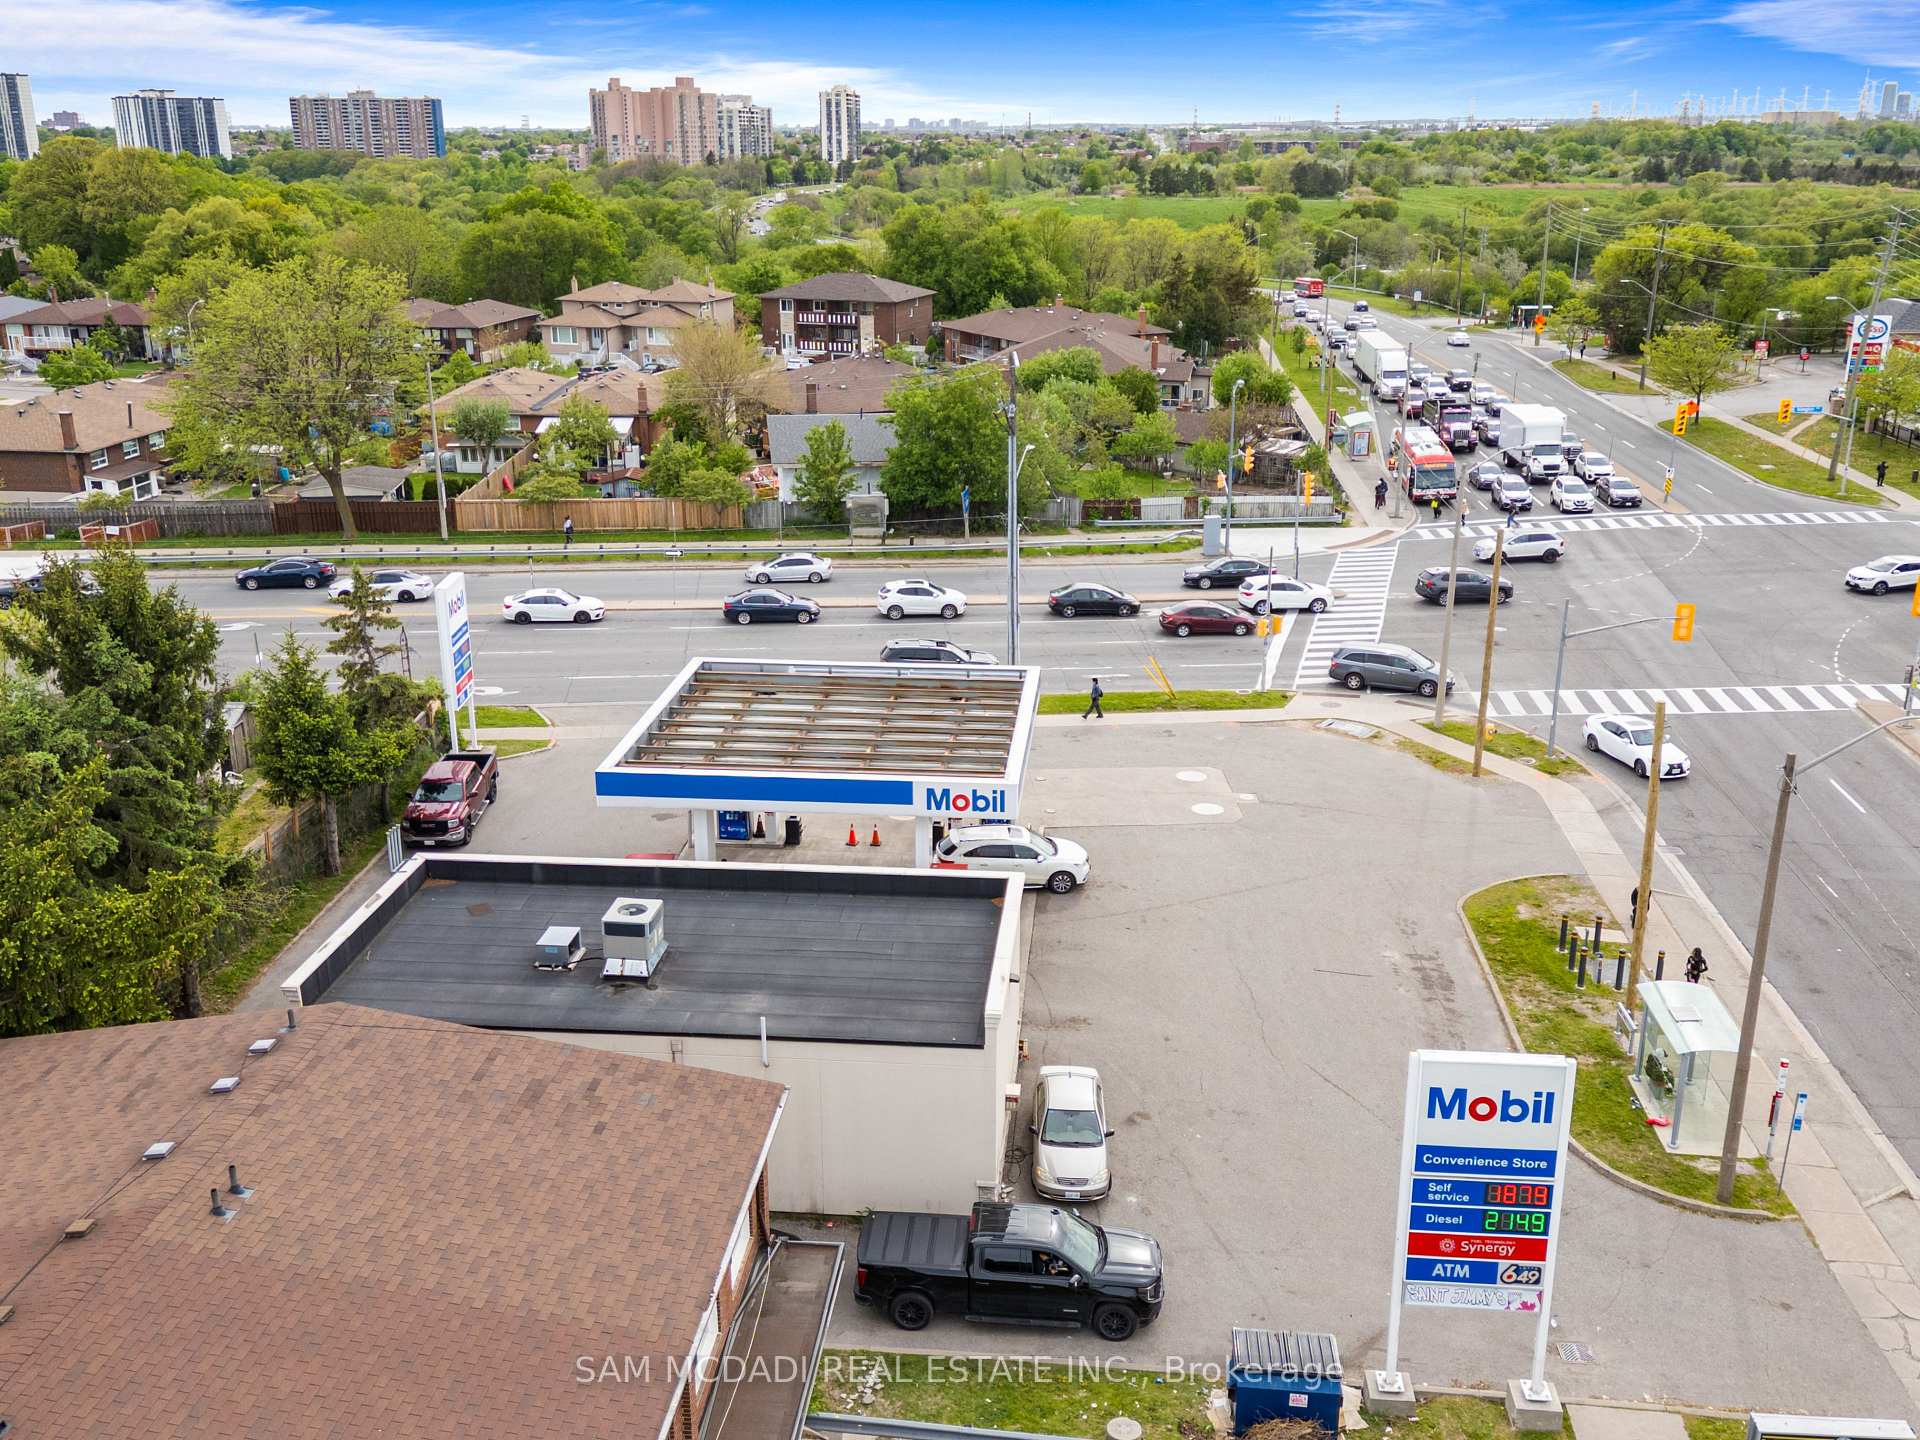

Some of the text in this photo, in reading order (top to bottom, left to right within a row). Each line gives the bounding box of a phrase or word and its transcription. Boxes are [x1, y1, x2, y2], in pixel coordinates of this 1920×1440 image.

[926, 787, 1006, 813] Mobil
[1427, 1086, 1555, 1124] Mobil
[1423, 1153, 1548, 1169] Convenience Store
[1428, 1182, 1452, 1192] Self
[1427, 1192, 1470, 1202] service
[1425, 1213, 1463, 1224] Diesel
[1460, 1241, 1516, 1256] Synergy
[1432, 1263, 1470, 1278] ATM
[1407, 1285, 1449, 1303] SAINT
